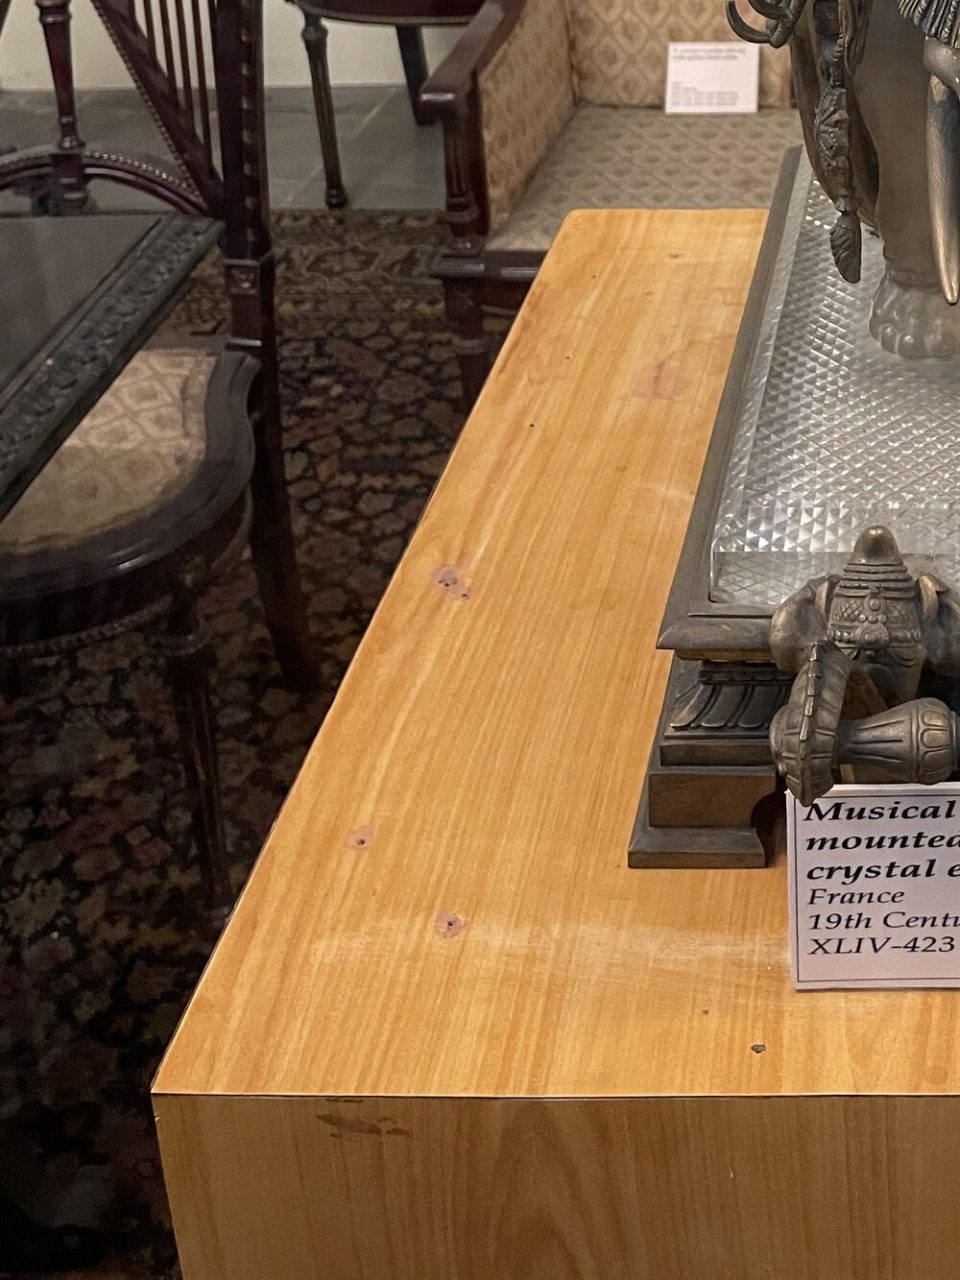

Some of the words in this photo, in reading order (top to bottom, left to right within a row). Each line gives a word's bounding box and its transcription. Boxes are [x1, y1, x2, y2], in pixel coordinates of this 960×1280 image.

[802, 800, 956, 821] Musical
[806, 858, 937, 886] crystal
[808, 888, 905, 906] France
[808, 911, 873, 930] 19th
[808, 936, 956, 955] XLIV-423
